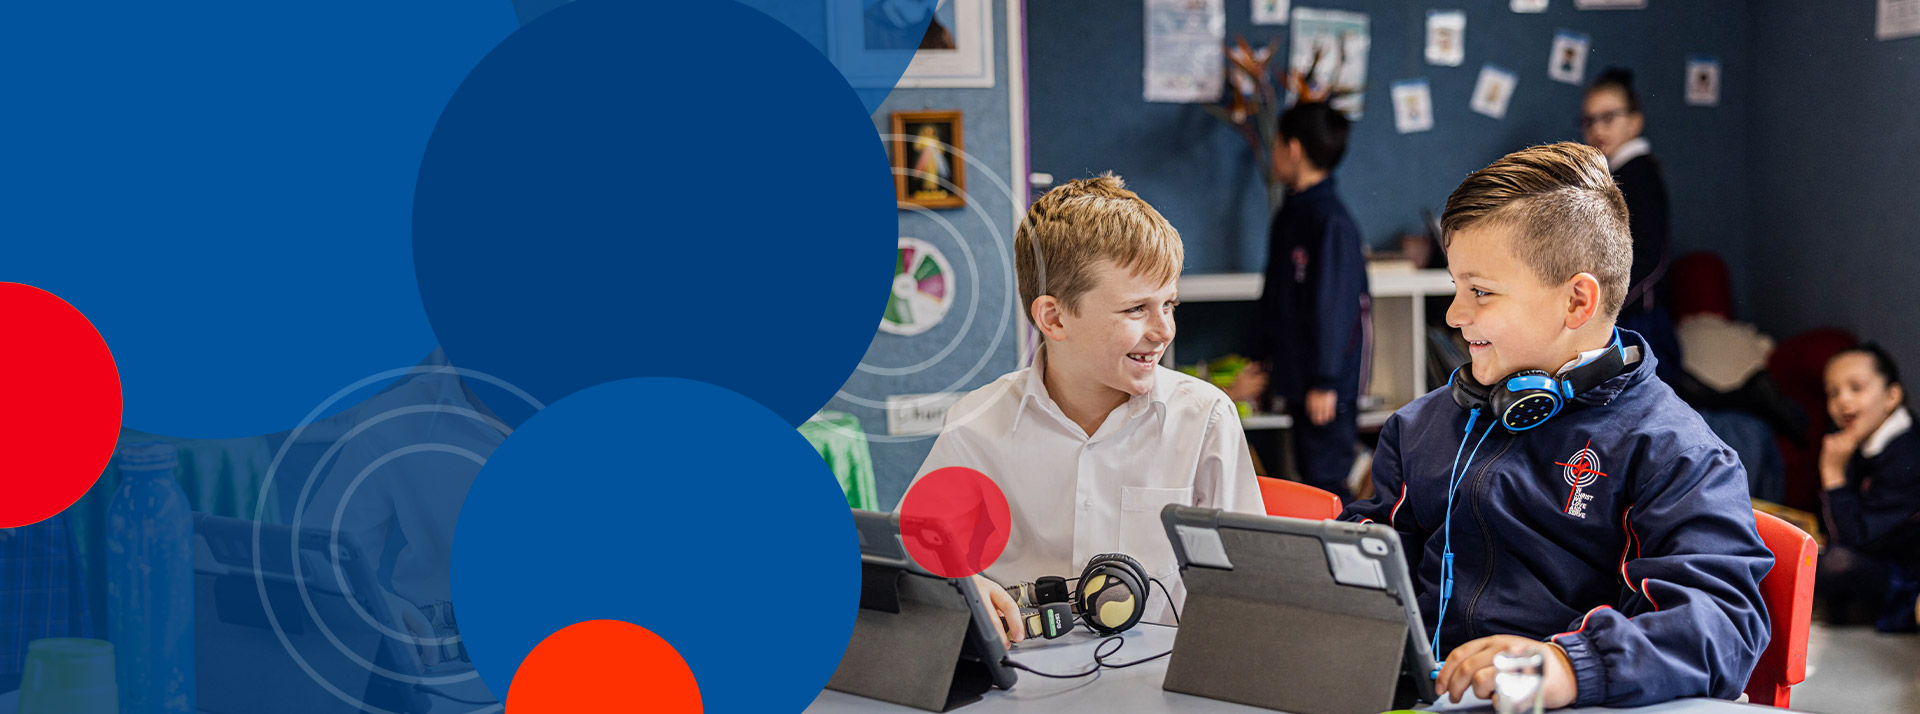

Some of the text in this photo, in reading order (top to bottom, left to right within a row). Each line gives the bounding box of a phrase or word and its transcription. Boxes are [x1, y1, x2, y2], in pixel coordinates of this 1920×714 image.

[1575, 492, 1594, 501] CHRIST
[1572, 500, 1587, 509] LOVE
[1568, 510, 1586, 519] SERVE
